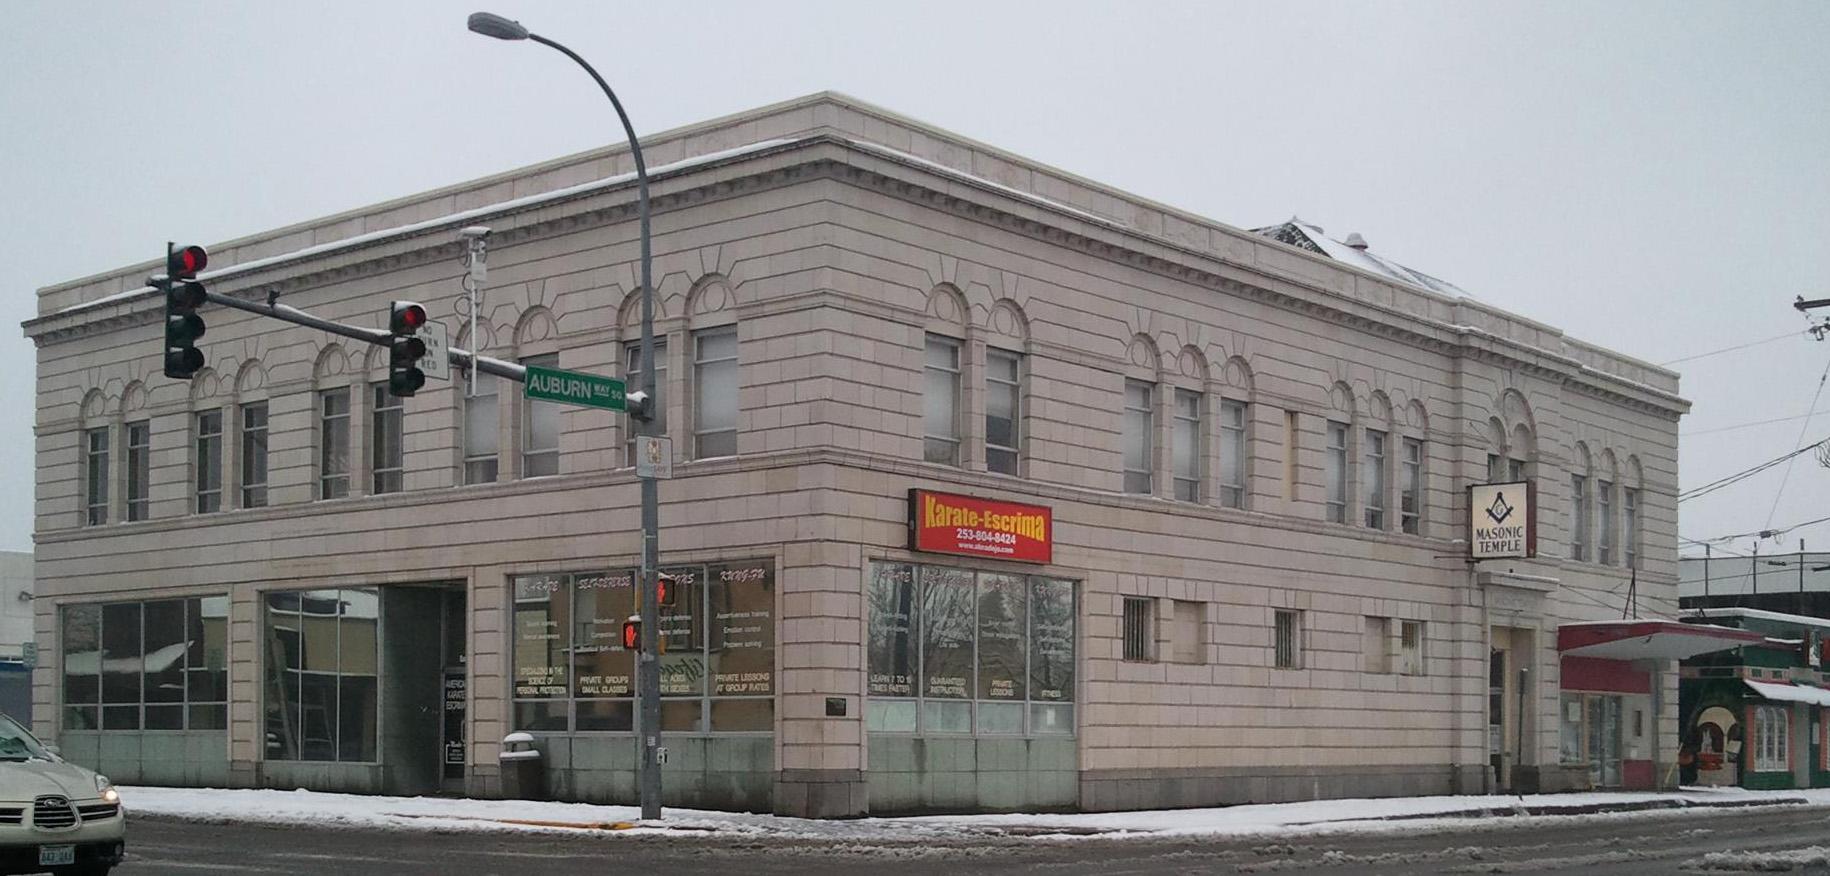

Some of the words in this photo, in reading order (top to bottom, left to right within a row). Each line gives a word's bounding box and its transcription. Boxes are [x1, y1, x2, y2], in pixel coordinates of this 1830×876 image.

[529, 374, 592, 399] AUBURN
[593, 383, 610, 393] WAY
[925, 494, 1045, 542] Karate-Escrima
[956, 528, 1016, 545] 253-804-8424
[1476, 526, 1523, 540] MASONIC
[1479, 539, 1521, 553] TEMPLE
[580, 675, 602, 684] PRIVATE
[605, 675, 629, 684] GROUPS
[715, 673, 740, 682] PRIVATE
[741, 672, 770, 681] LESSONS
[582, 685, 600, 694] SMALL
[602, 685, 628, 693] CLASSES
[715, 683, 724, 692] AT
[725, 683, 747, 692] GROUP
[748, 682, 770, 692] RATES
